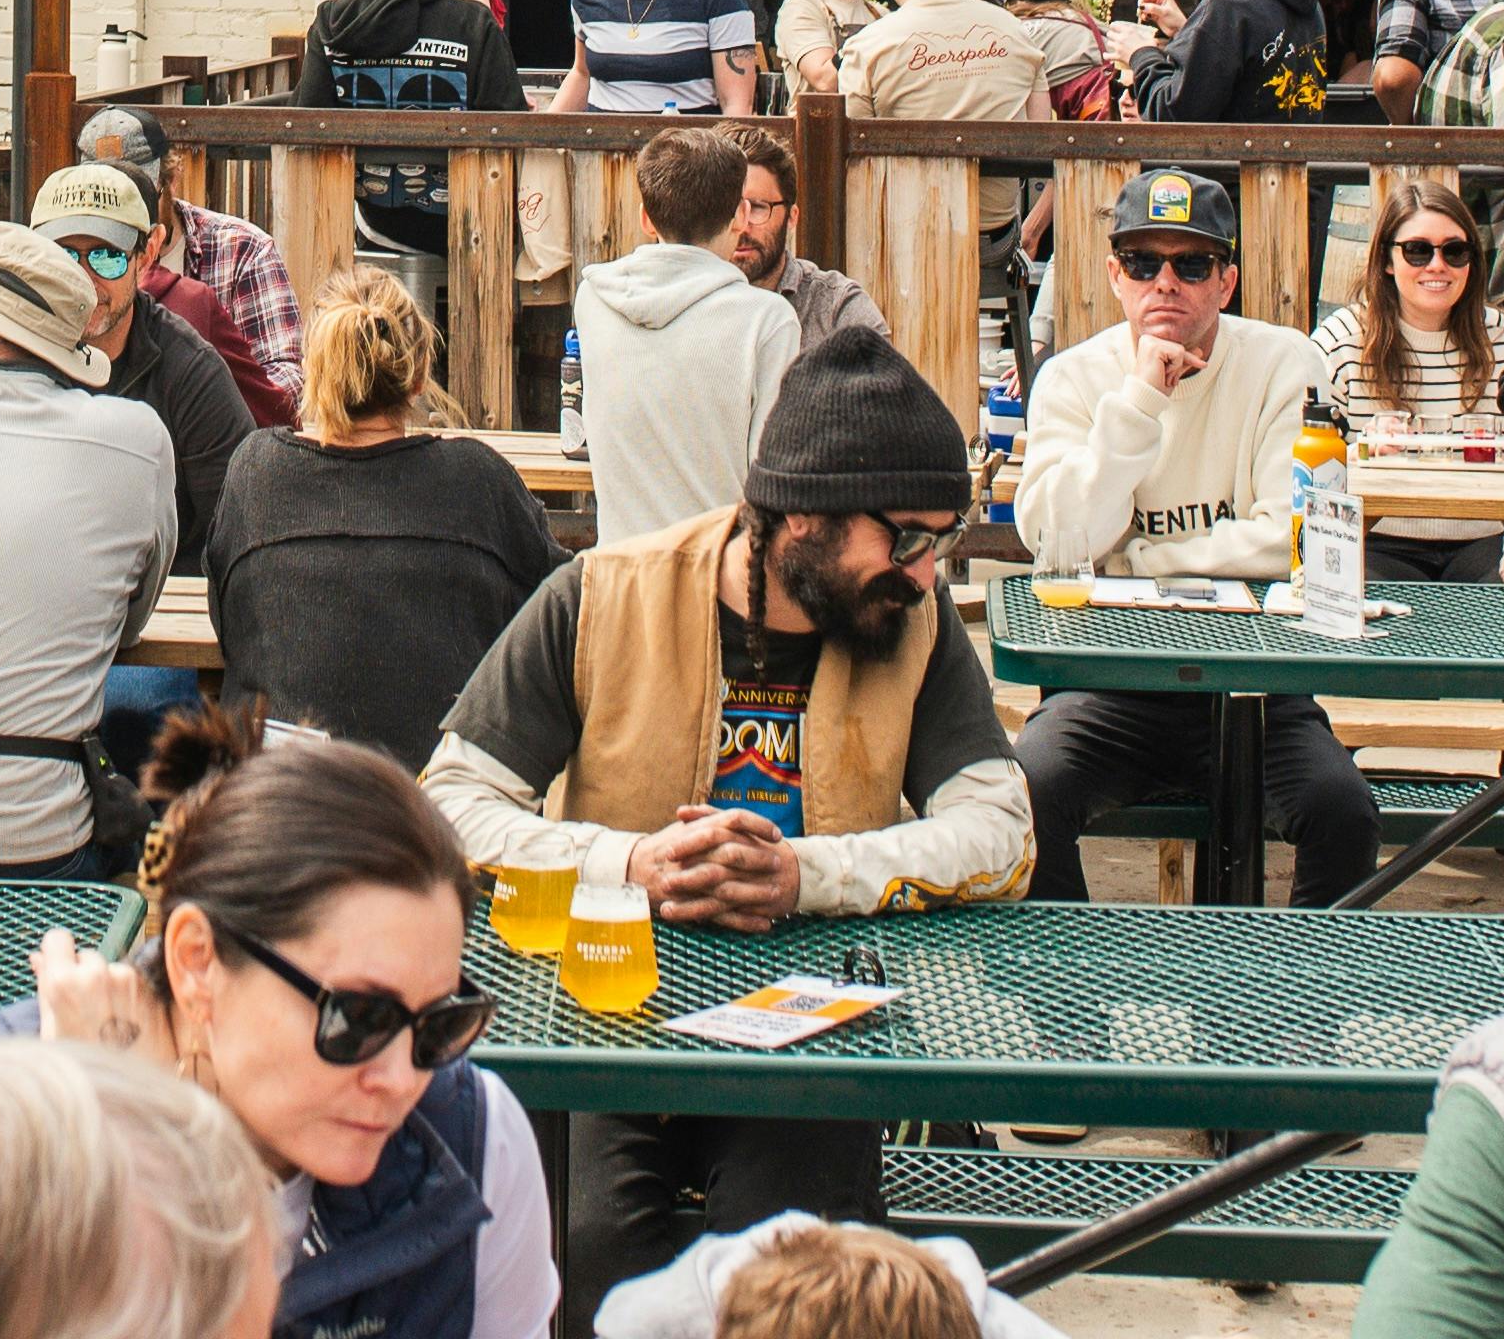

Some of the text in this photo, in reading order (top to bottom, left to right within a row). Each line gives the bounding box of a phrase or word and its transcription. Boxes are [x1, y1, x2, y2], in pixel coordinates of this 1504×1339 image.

[415, 41, 467, 59] ANTHEM
[908, 41, 1009, 71] Beerspoke
[353, 58, 377, 67] NORTH
[379, 58, 412, 67] AMERICA
[52, 190, 121, 208] OLIVE MILL
[1131, 498, 1236, 536] SENTIA
[576, 941, 633, 956] CEREBRAL
[583, 953, 624, 963] BREWING
